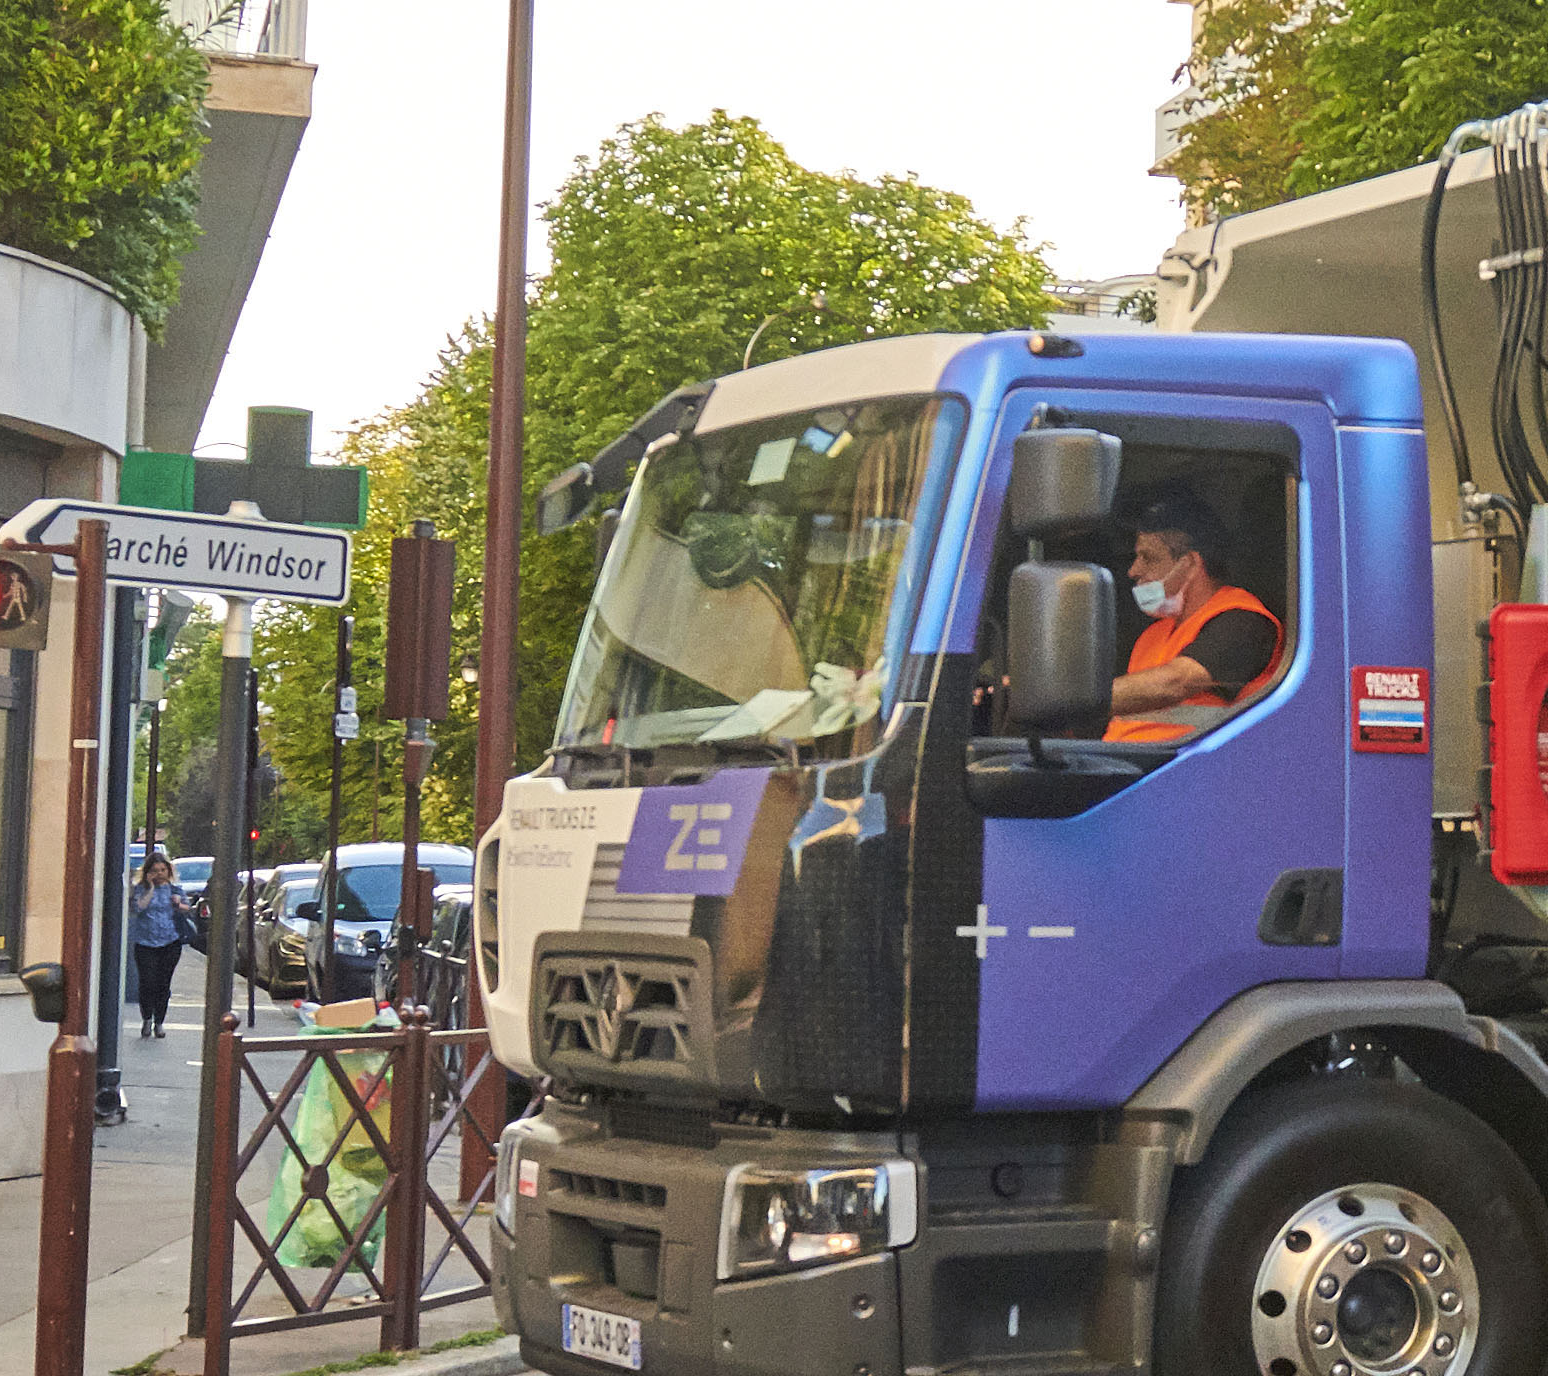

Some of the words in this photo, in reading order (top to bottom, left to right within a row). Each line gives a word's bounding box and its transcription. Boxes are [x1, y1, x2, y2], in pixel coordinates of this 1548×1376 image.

[107, 536, 188, 568] arché
[207, 538, 327, 582] Windsor
[1366, 672, 1419, 686] RENAULT
[1368, 684, 1420, 699] TRUCKS
